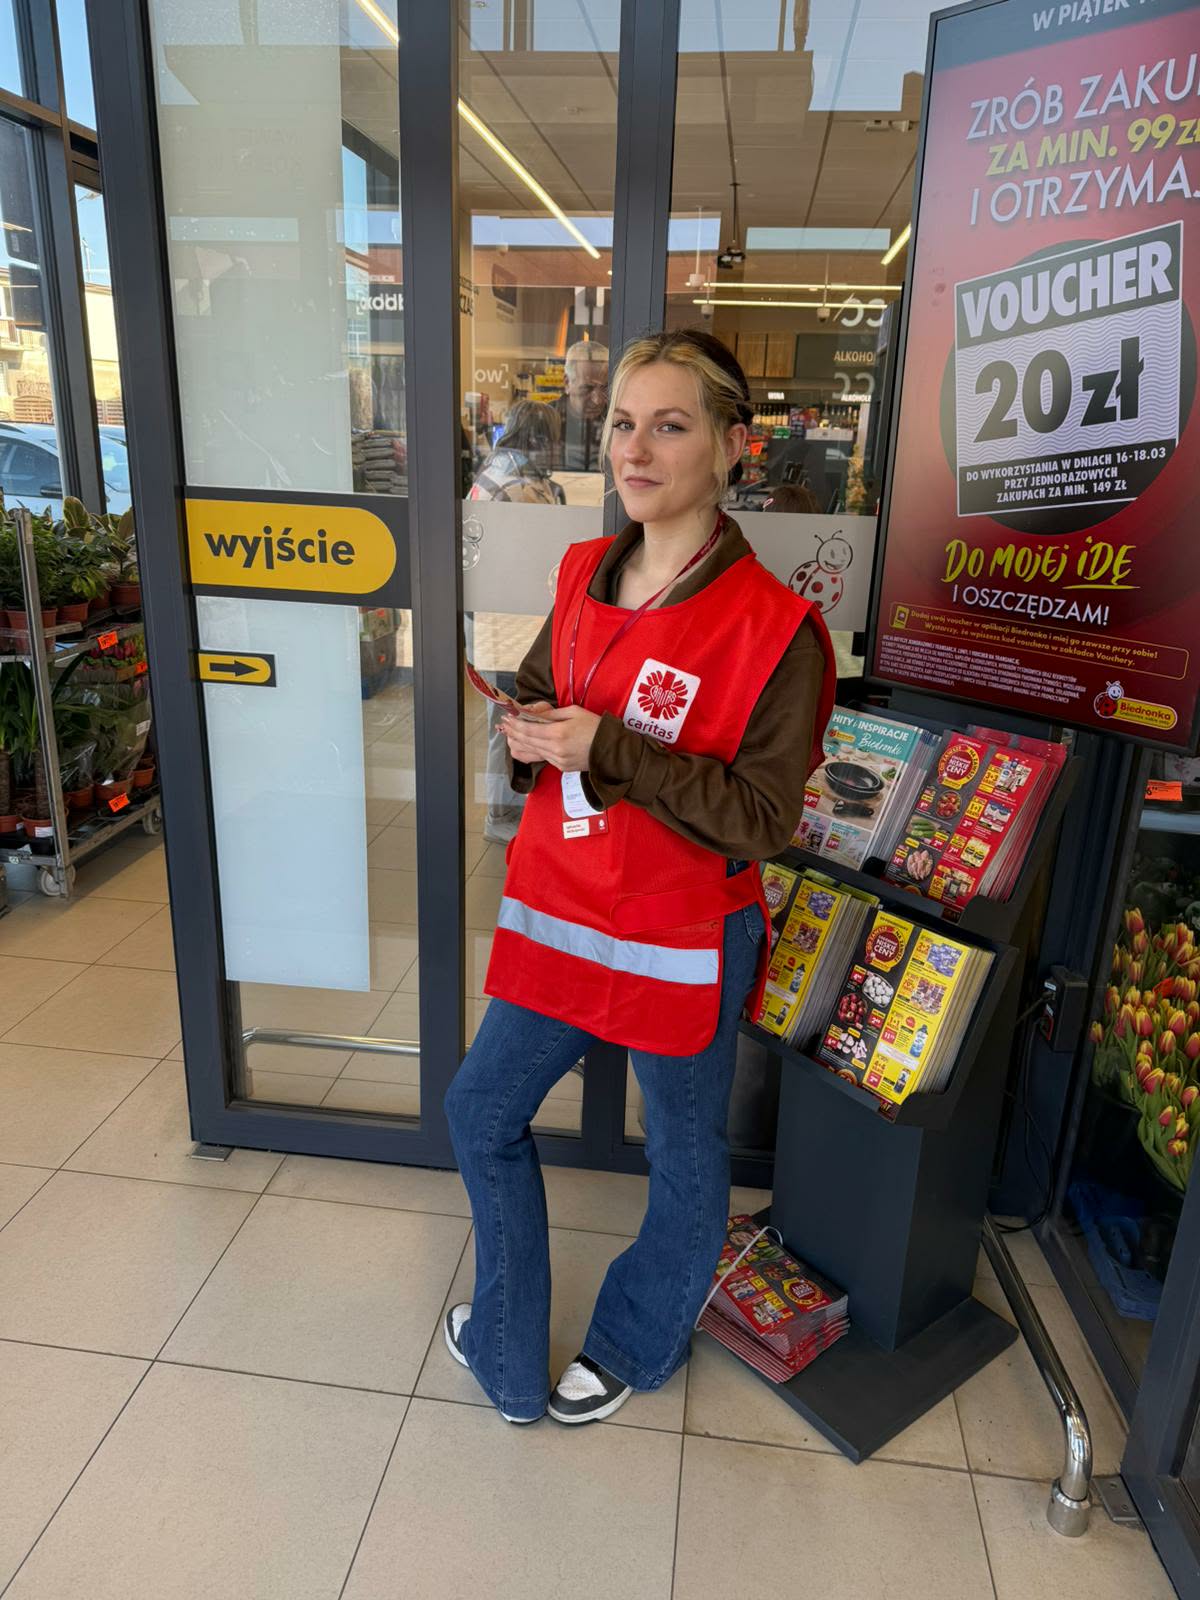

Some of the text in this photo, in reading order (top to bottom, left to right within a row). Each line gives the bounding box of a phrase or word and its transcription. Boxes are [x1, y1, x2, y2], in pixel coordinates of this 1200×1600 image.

[1032, 8, 1055, 32] W
[966, 53, 1200, 140] ZRÓB ZAKU
[985, 141, 1029, 177] ZA
[1036, 125, 1118, 169] MIN.
[970, 155, 1200, 225] I OTRZYMA
[961, 240, 1173, 339] VOUCHER
[973, 336, 1145, 444] 20 zł
[966, 447, 1167, 482] DO WYKORZYSTANIA W DNIACH 16-18.03
[1004, 466, 1118, 490] PRZY JEDNORAZOWYCH
[996, 479, 1128, 503] ZAKUPACH ZA MIN. 149 ZŁ
[204, 525, 356, 570] wyjście
[952, 584, 1110, 626] I OSZCZĘDZAM!
[1112, 645, 1132, 655] przy
[1132, 648, 1158, 659] sobie!
[1120, 702, 1171, 721] Biedronka
[627, 718, 674, 740] caritas
[832, 713, 852, 727] HITY
[857, 720, 910, 742] INSPIRACJE
[874, 945, 894, 957] CENY
[876, 938, 897, 952] NISKIE
